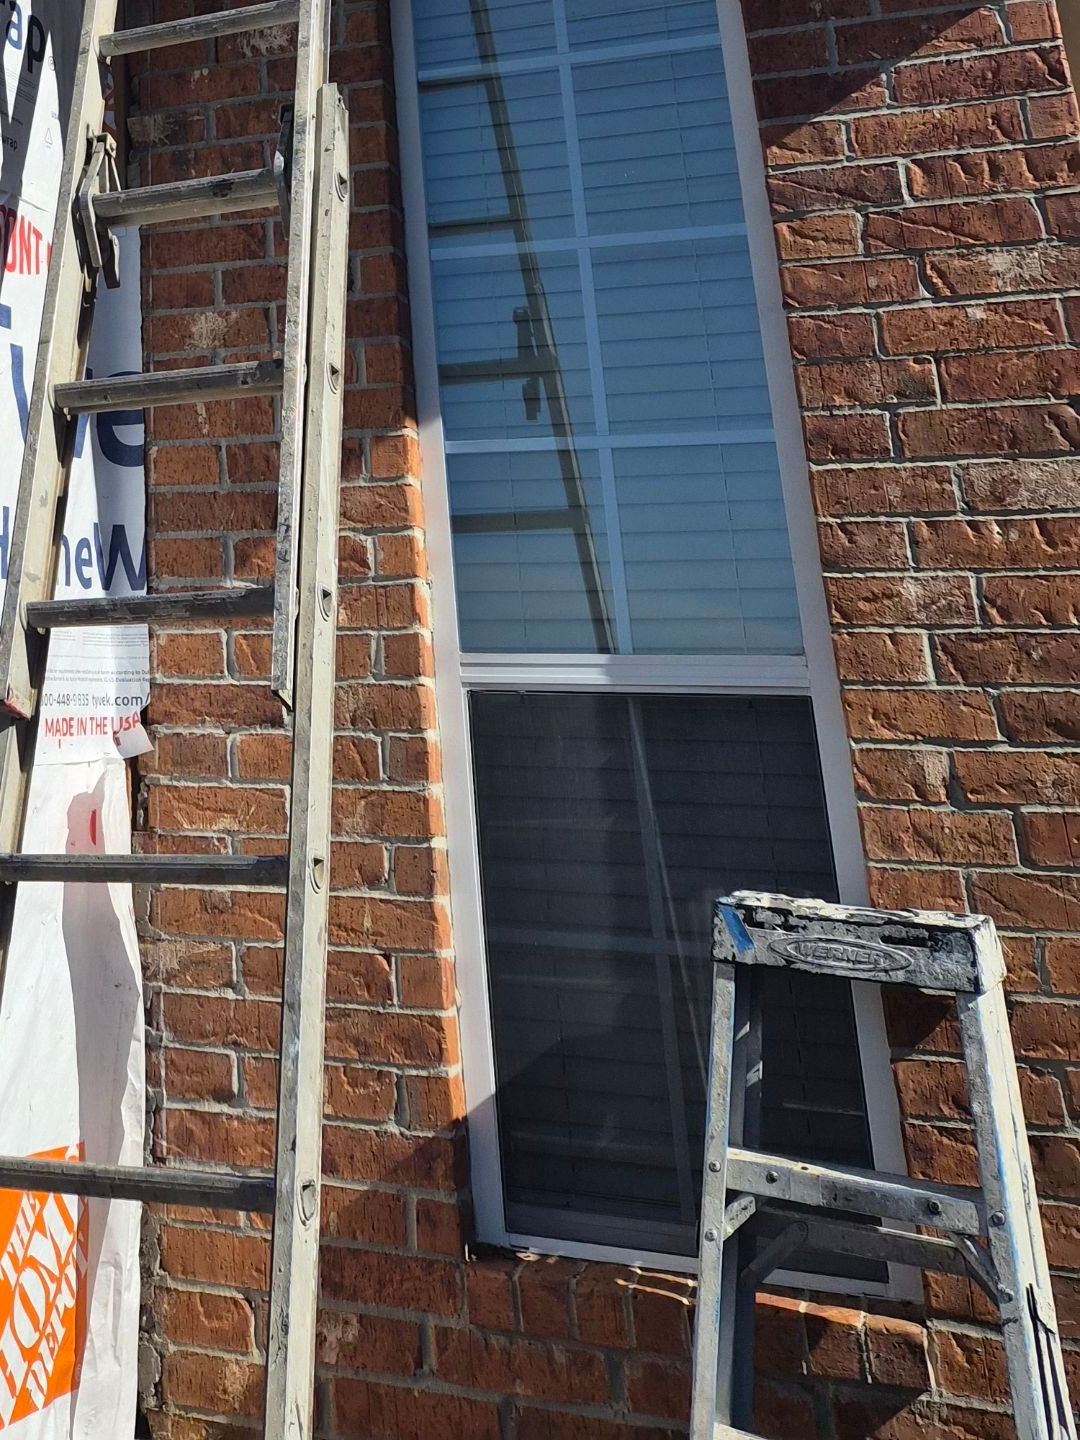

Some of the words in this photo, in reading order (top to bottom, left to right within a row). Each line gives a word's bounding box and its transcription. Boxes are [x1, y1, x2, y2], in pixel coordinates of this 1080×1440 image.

[45, 717, 74, 737] MADE
[77, 716, 87, 736] IN
[89, 716, 108, 736] THE
[111, 710, 141, 735] USA
